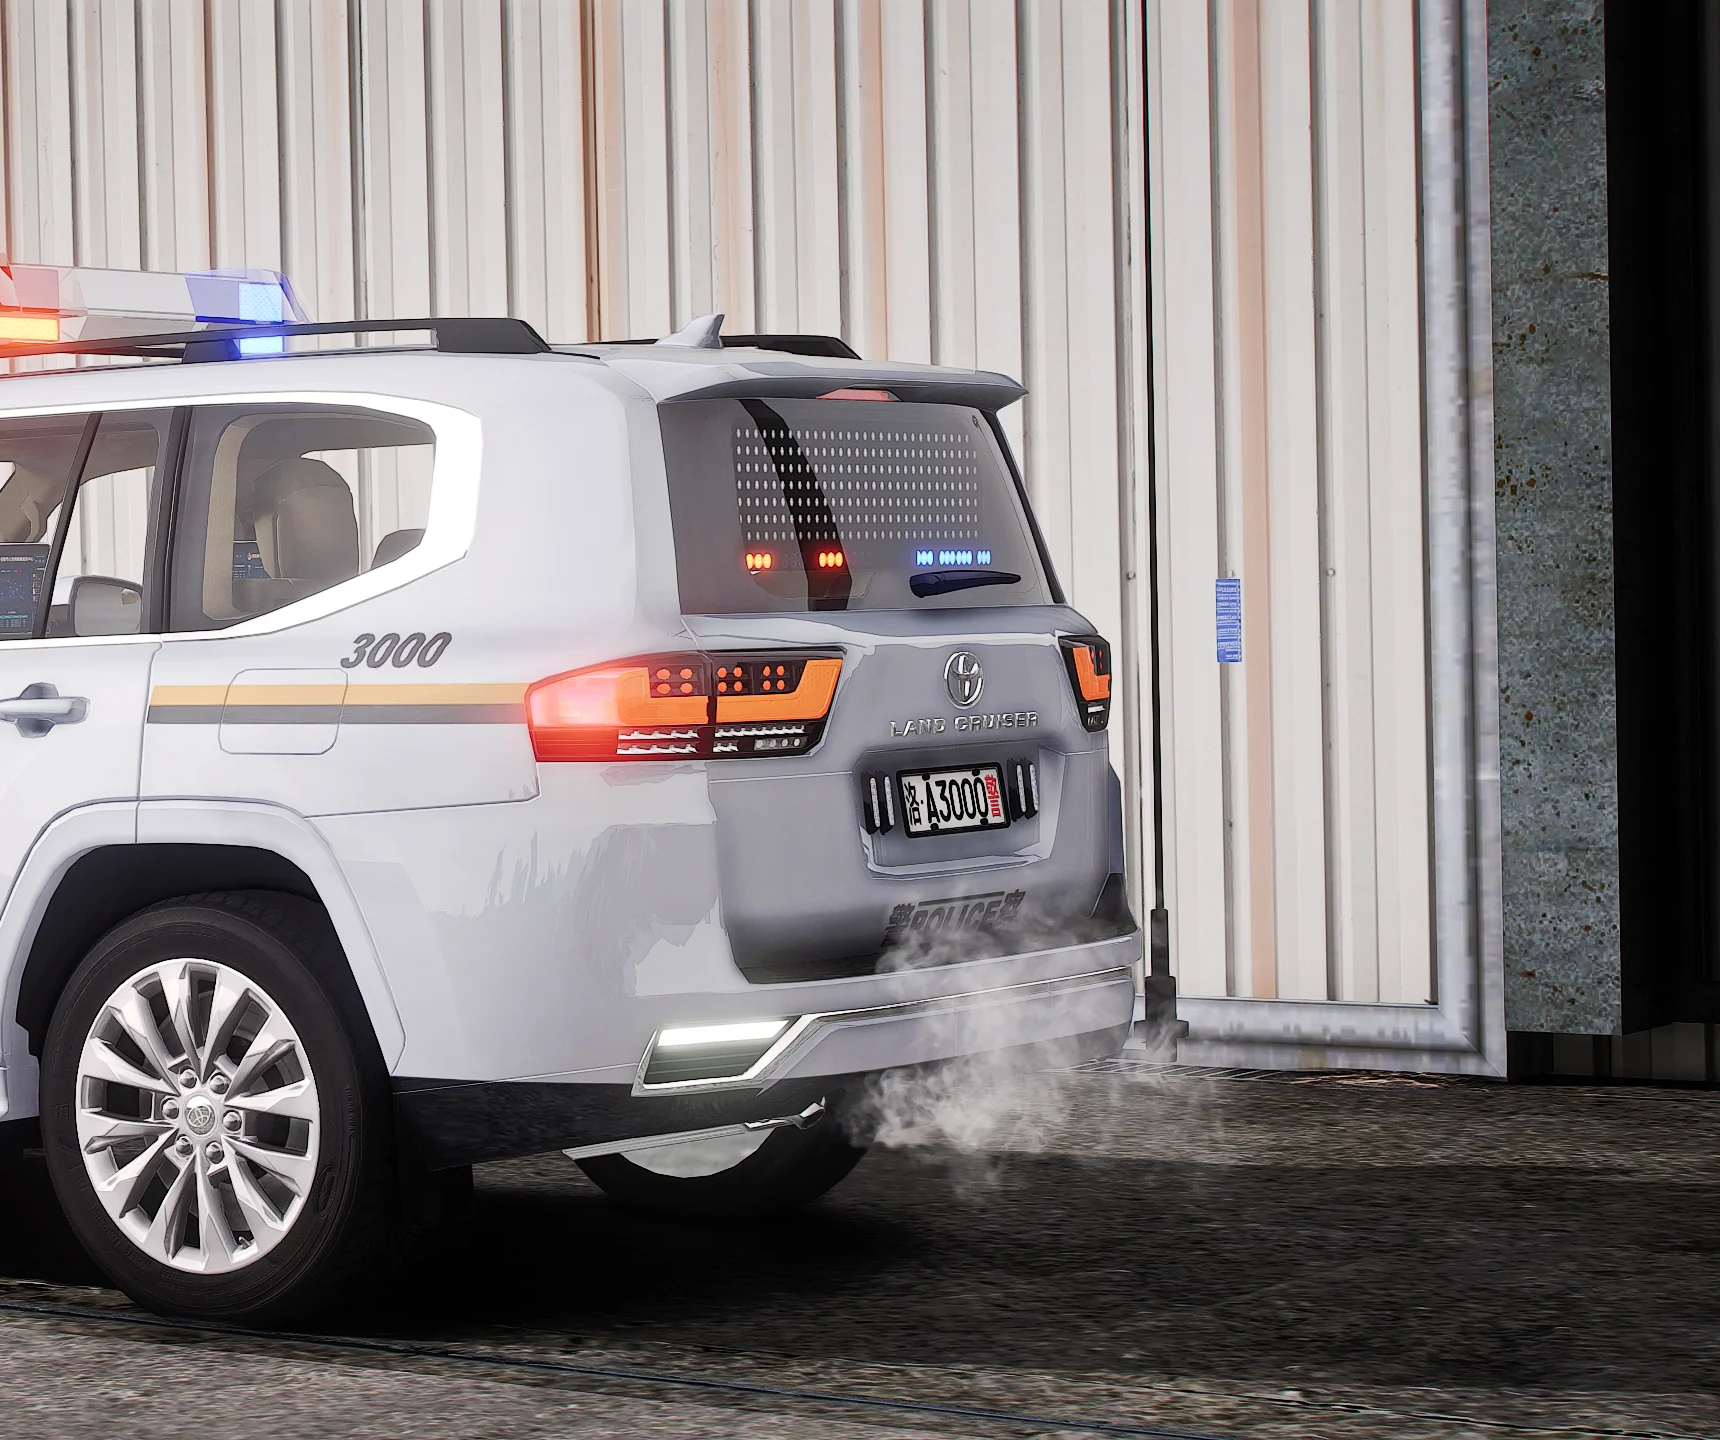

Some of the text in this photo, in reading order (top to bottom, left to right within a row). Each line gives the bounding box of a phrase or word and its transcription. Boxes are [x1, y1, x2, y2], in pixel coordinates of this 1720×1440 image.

[340, 631, 453, 669] 3000
[889, 711, 1039, 738] LAND CRUISER
